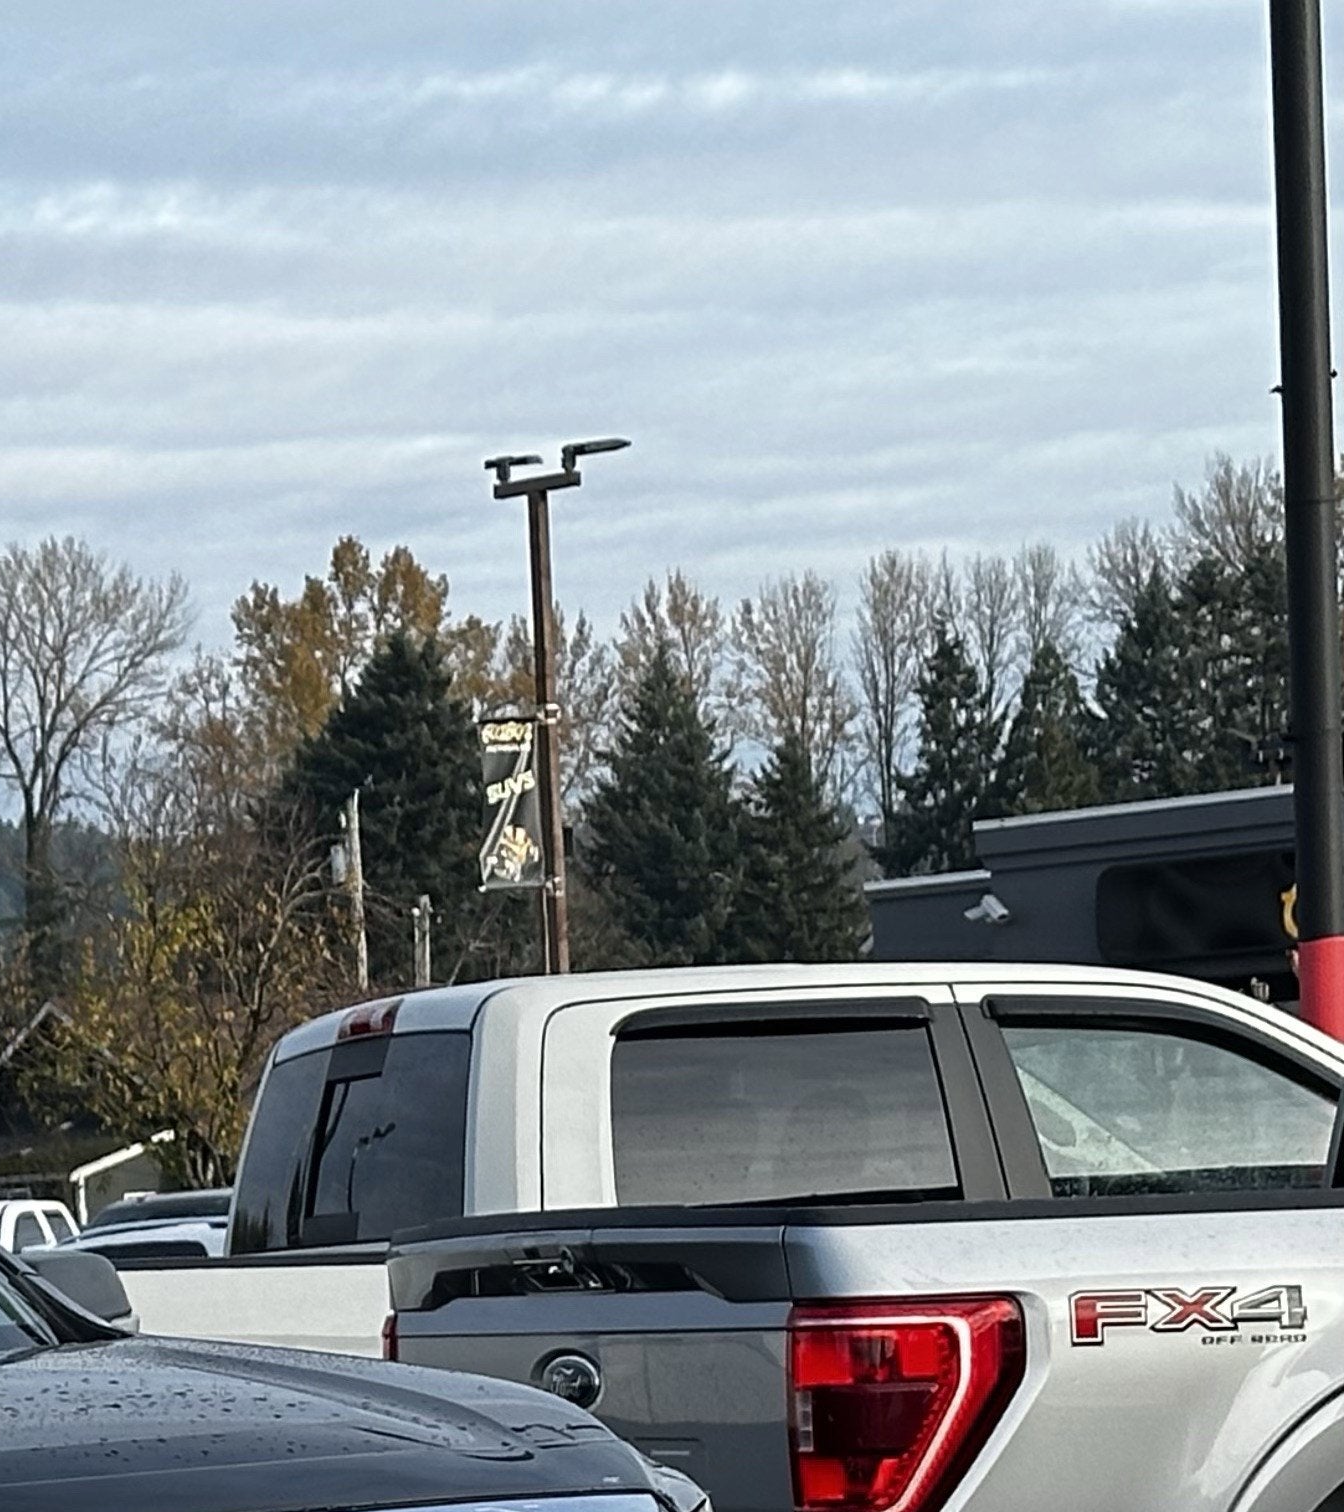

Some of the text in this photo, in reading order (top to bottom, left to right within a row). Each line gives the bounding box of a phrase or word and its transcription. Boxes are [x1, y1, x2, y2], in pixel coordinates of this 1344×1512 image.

[1069, 1284, 1308, 1348] FX4
[1201, 1334, 1307, 1345] OFF ROAD
